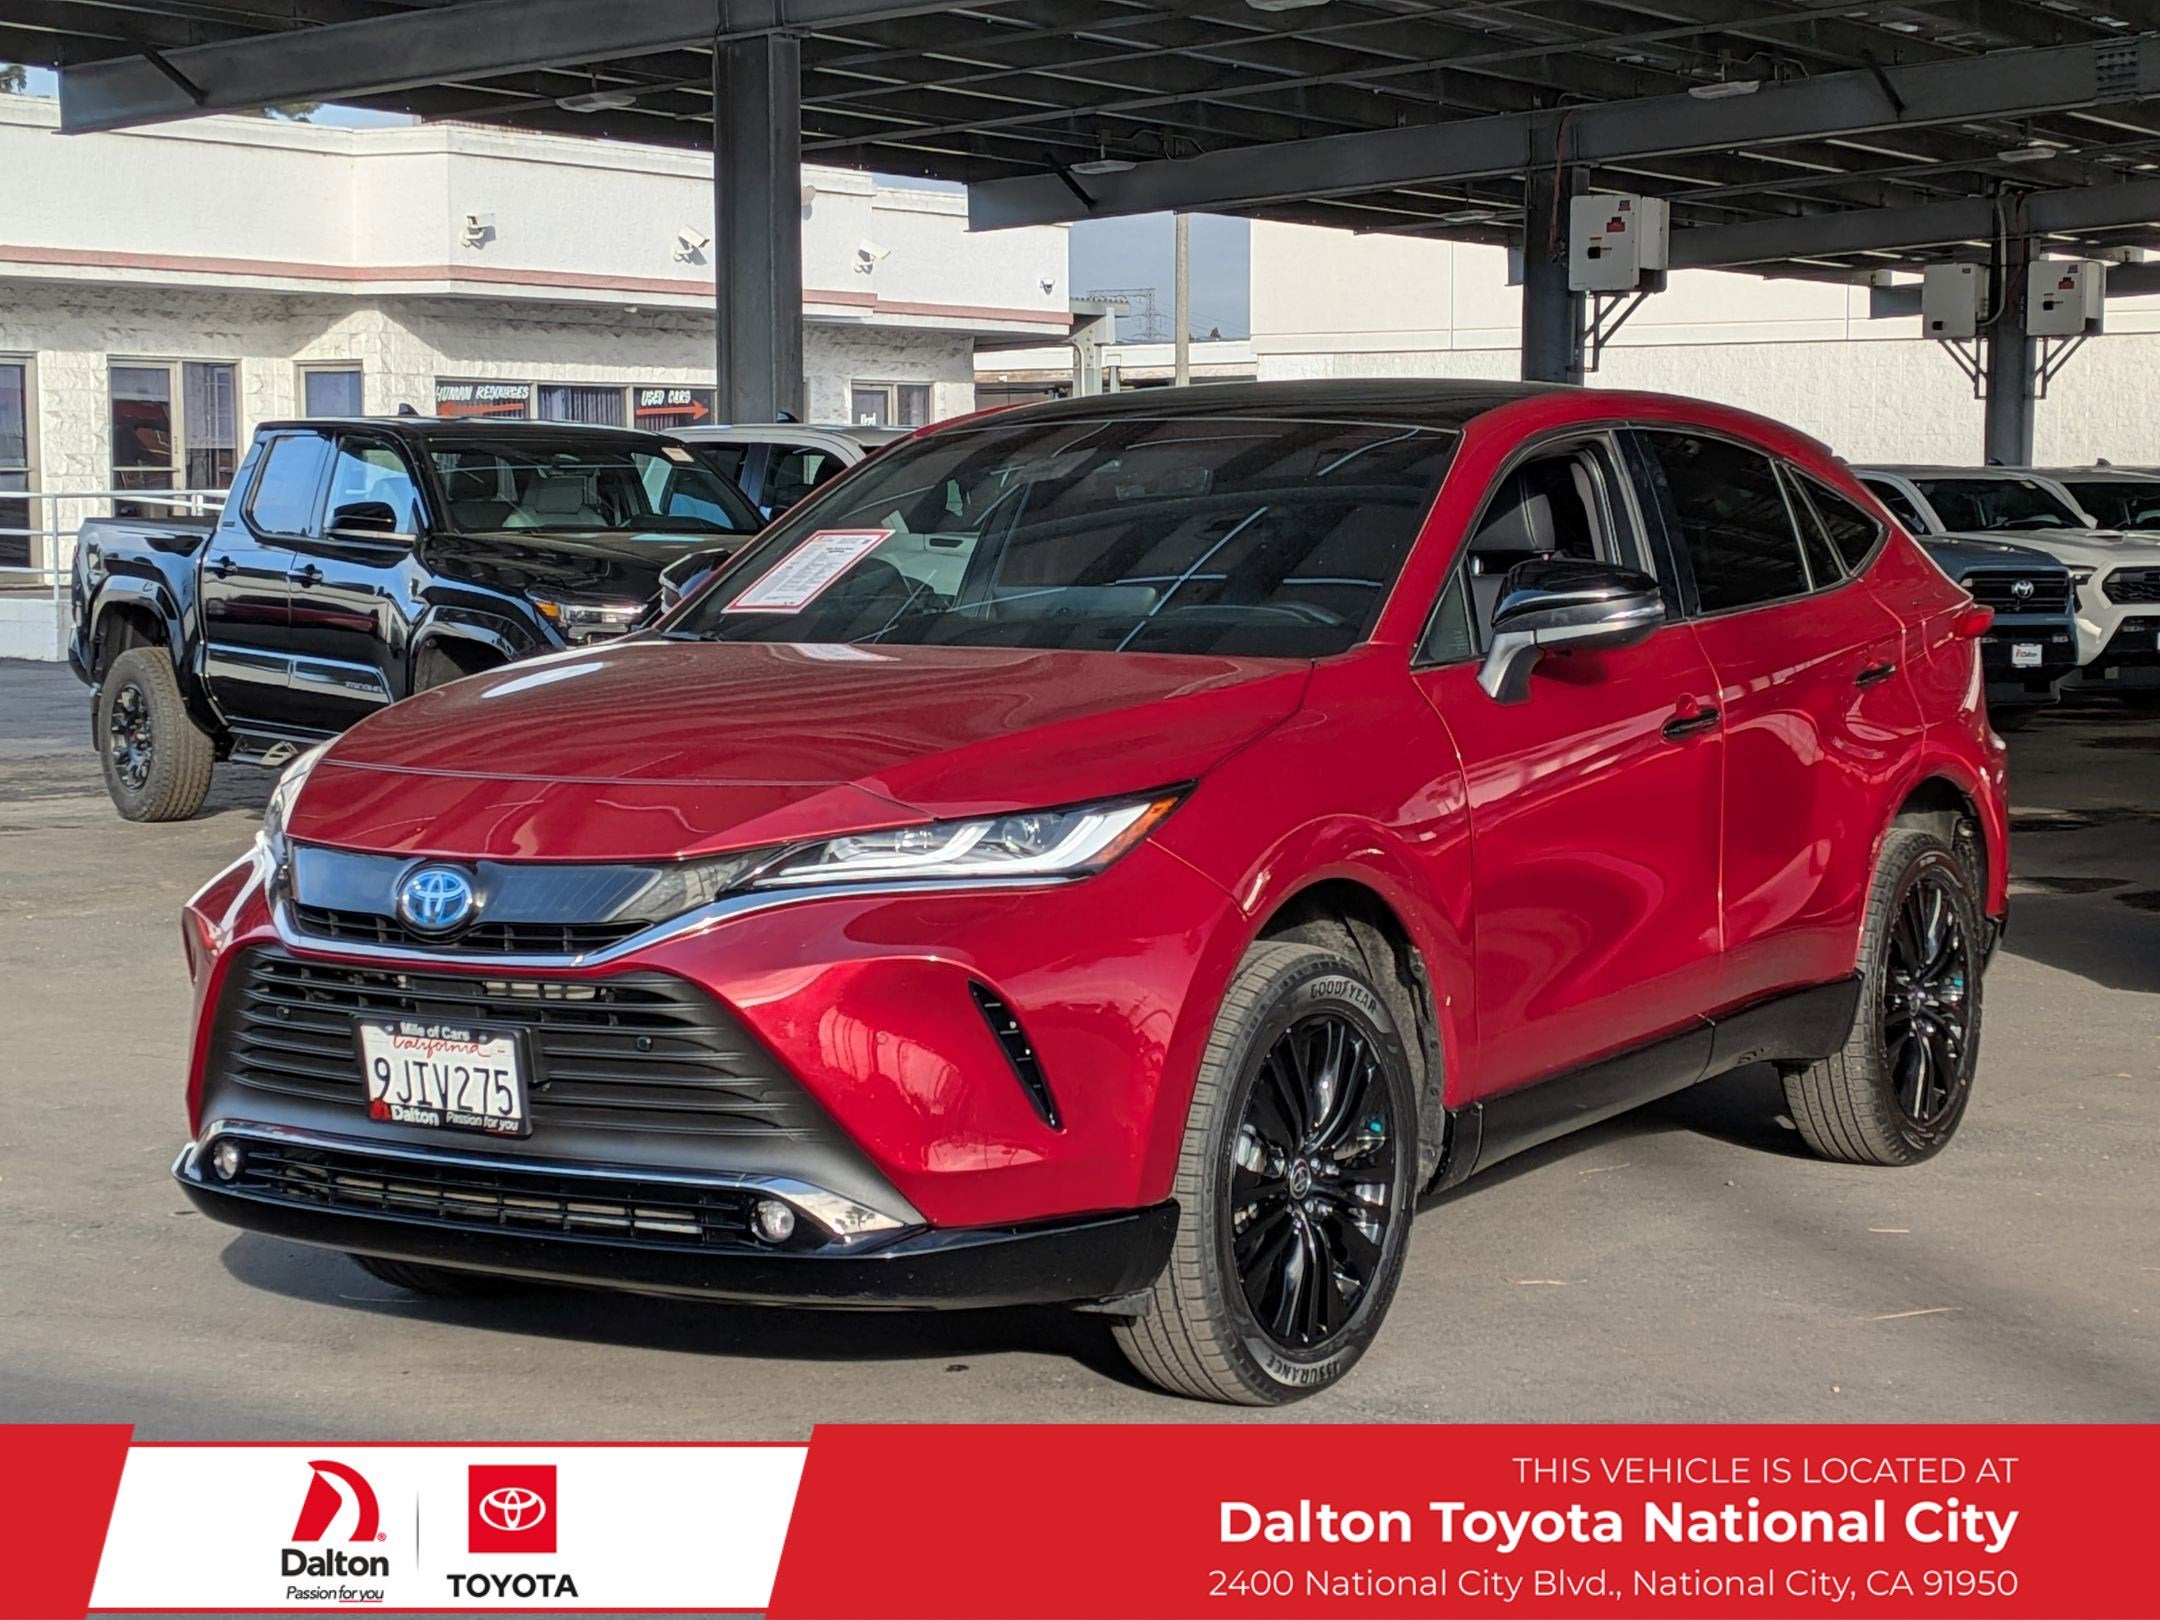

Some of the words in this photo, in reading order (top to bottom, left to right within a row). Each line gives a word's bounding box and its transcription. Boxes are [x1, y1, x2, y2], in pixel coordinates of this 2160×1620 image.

[436, 385, 473, 401] HUMAN
[475, 384, 529, 400] RESOURCES
[641, 390, 665, 406] USED
[668, 390, 691, 404] CARS
[1311, 980, 1377, 1014] GOODYEAR
[400, 1021, 425, 1037] Mile
[426, 1025, 440, 1038] of
[441, 1027, 471, 1041] Cars
[374, 1056, 514, 1116] 9JIV275
[391, 1105, 440, 1127] Dalton
[446, 1111, 482, 1127] Passion
[483, 1115, 499, 1128] for
[499, 1119, 519, 1132] you
[1266, 1353, 1341, 1384] ASSURANCE
